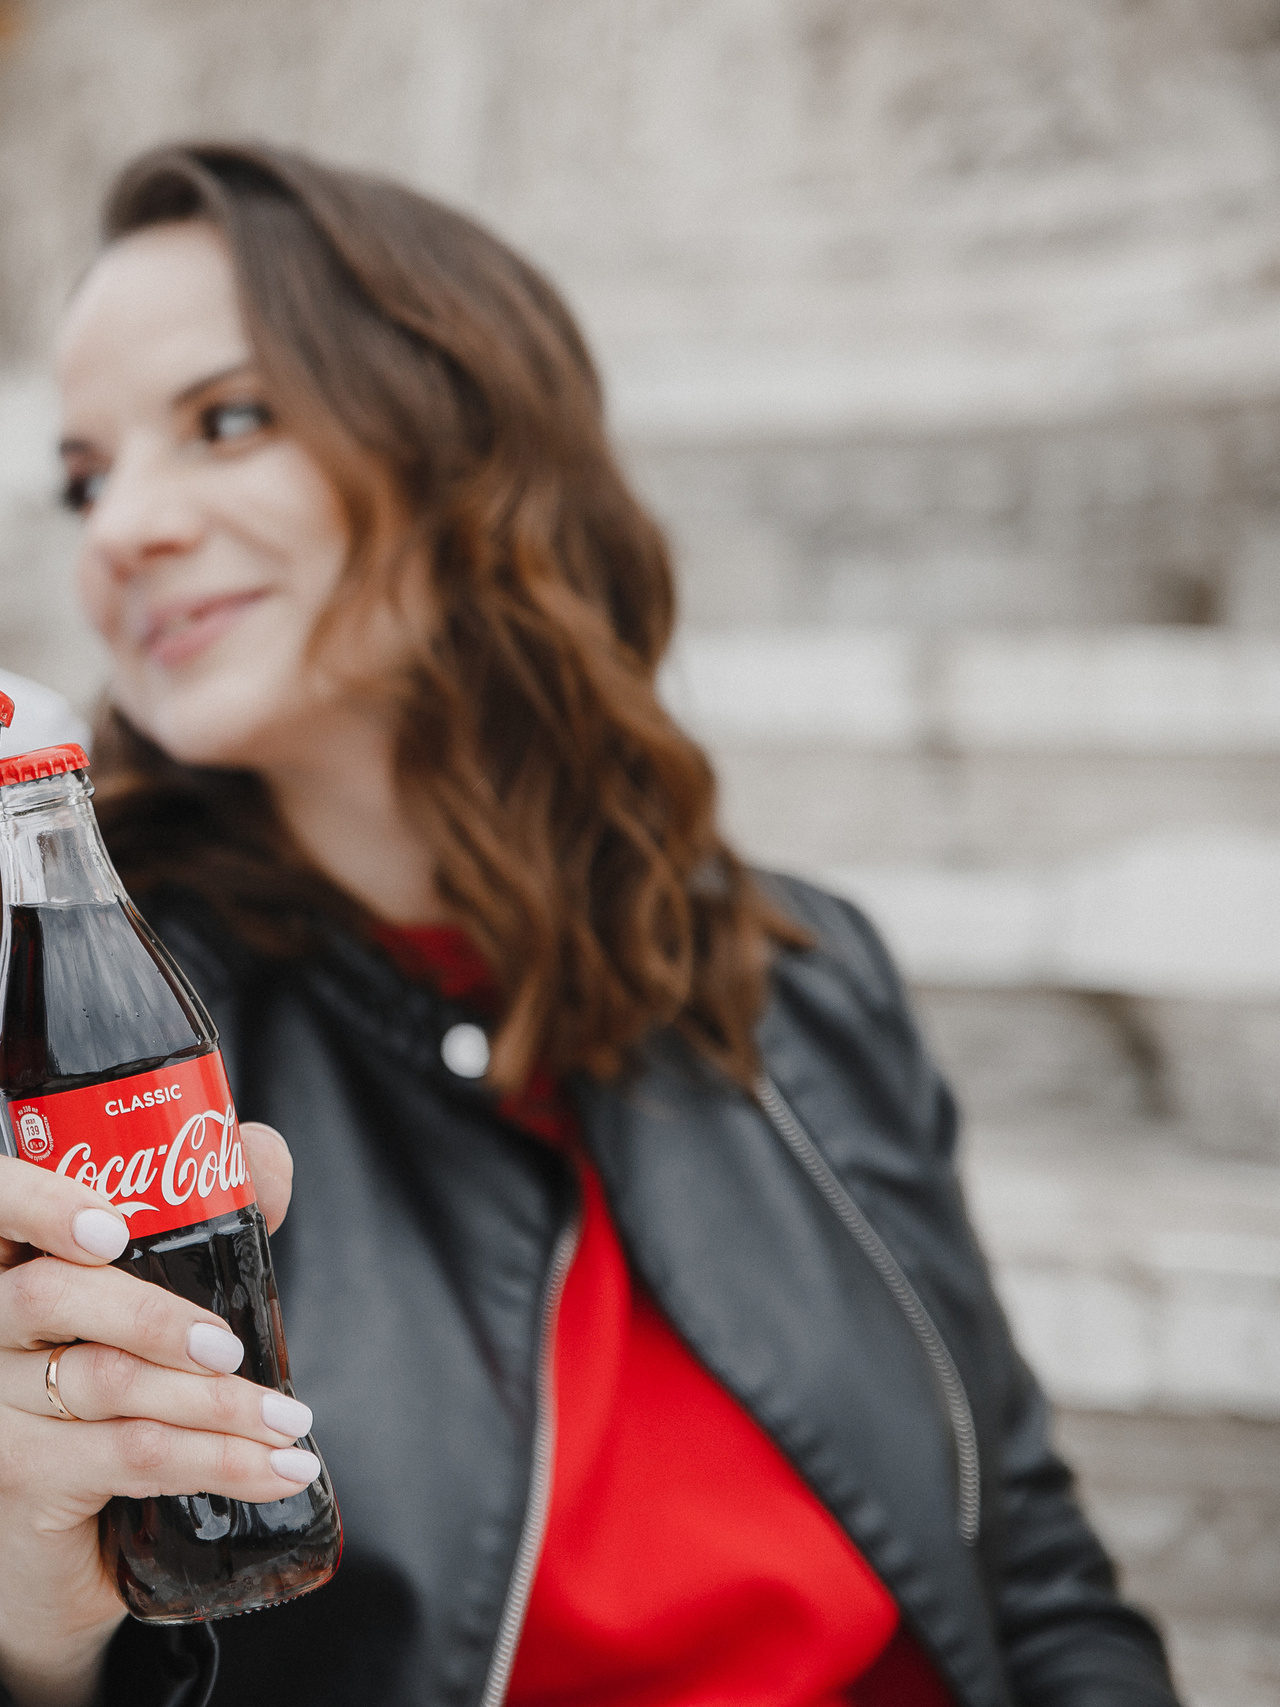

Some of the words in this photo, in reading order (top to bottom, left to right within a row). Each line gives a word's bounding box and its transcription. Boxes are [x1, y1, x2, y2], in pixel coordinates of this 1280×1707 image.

[104, 1084, 183, 1117] CLASSIC
[22, 1105, 31, 1113] 330
[26, 1125, 40, 1137] 139
